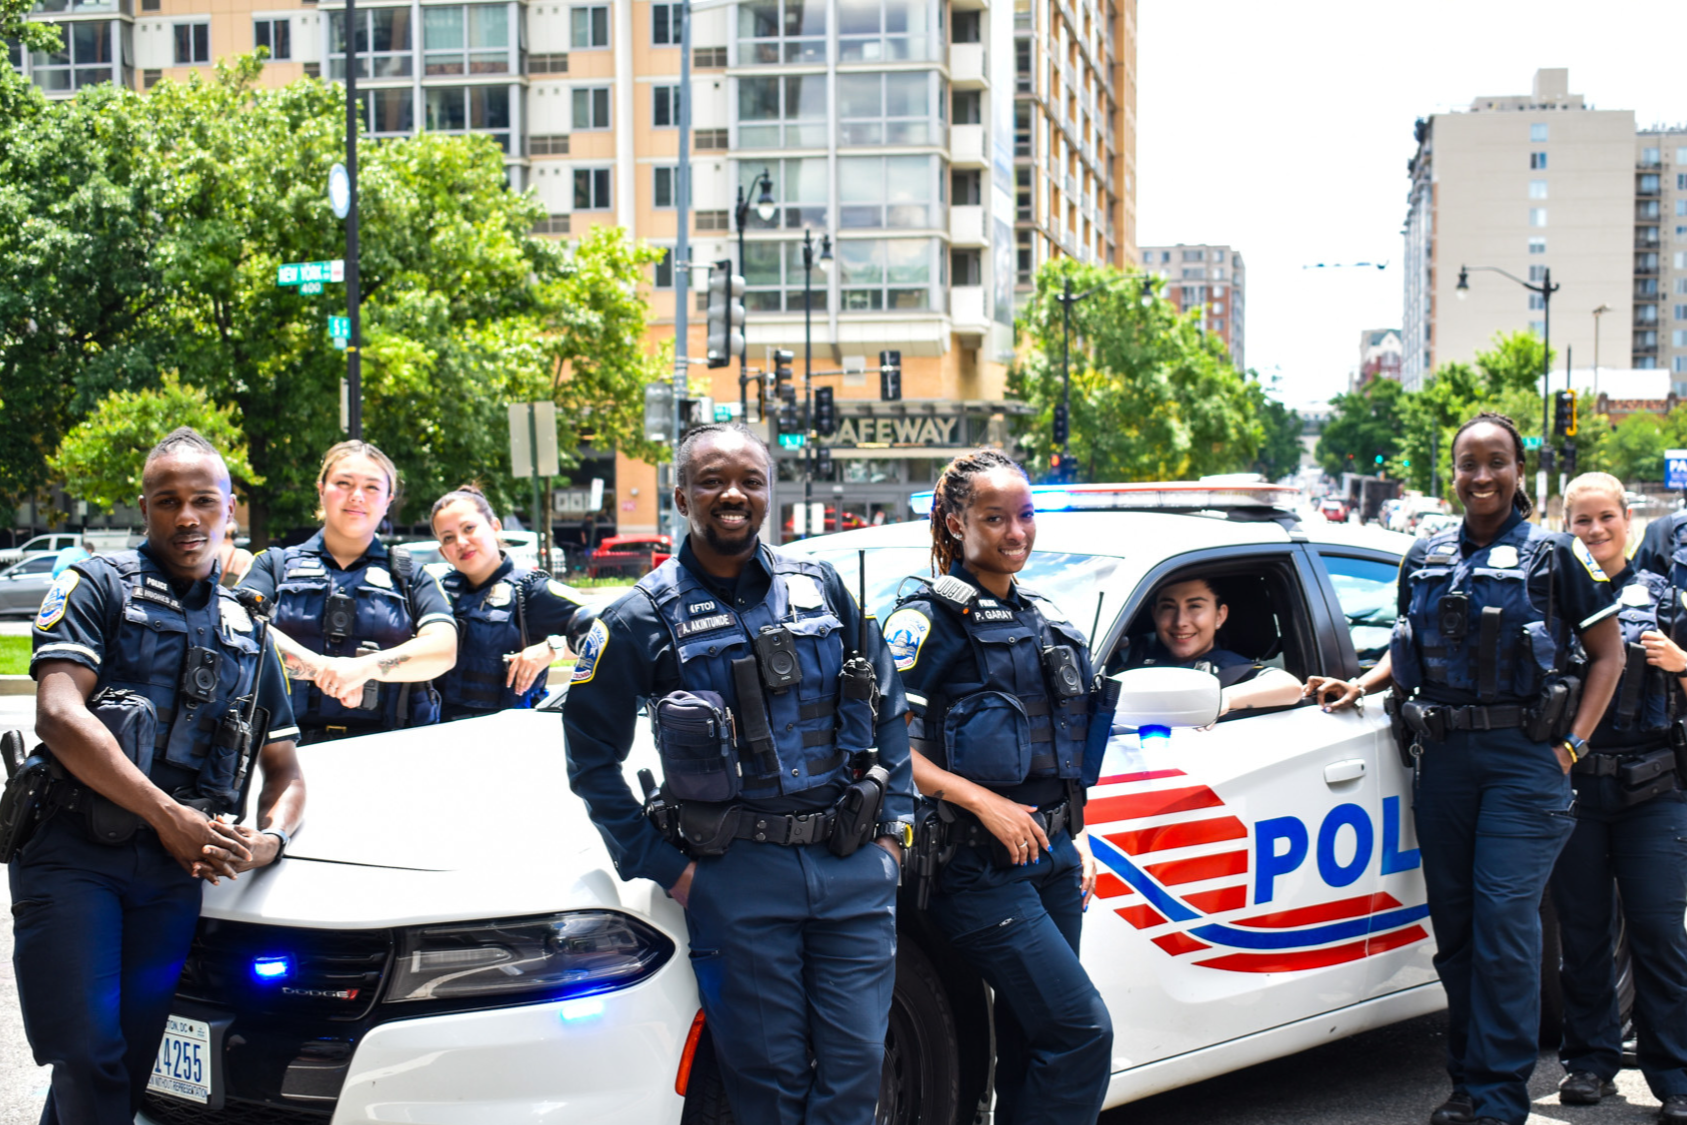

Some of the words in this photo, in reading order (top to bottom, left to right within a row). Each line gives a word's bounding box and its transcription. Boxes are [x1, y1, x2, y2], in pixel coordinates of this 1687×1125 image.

[279, 265, 299, 283] NEW
[300, 263, 323, 282] YORK
[301, 282, 321, 293] 400
[146, 577, 168, 591] POLICE
[144, 589, 170, 604] HUGHES
[690, 600, 716, 613] (FTO)
[974, 611, 985, 621] P.
[985, 610, 1013, 620] GARAY
[682, 623, 691, 634] A.
[691, 614, 730, 632] AKINTUNDE
[1254, 795, 1421, 905] POL
[282, 987, 349, 998] DODGE
[180, 1022, 188, 1033] DC
